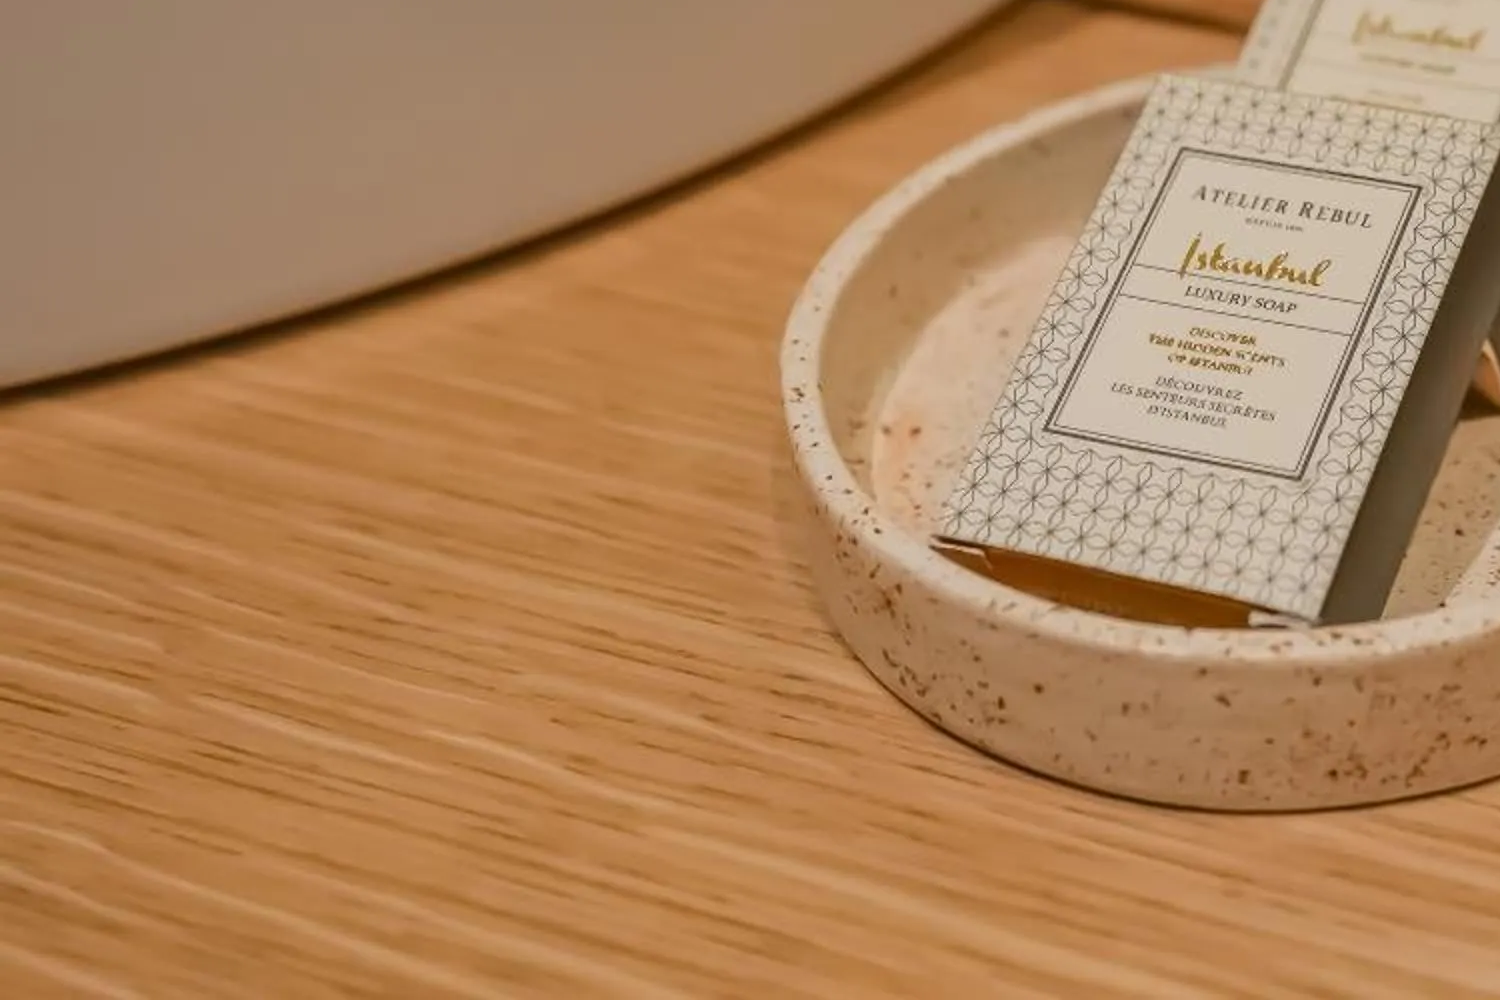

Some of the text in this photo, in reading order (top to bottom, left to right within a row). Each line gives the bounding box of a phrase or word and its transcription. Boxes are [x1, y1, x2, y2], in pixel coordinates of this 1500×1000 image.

[1192, 184, 1373, 229] ATELIER REBUL
[1184, 286, 1297, 313] LUXURY SOAP
[1189, 327, 1257, 346] DISCOVER
[1111, 381, 1134, 395] LES
[1135, 386, 1208, 411] SENTEURS
